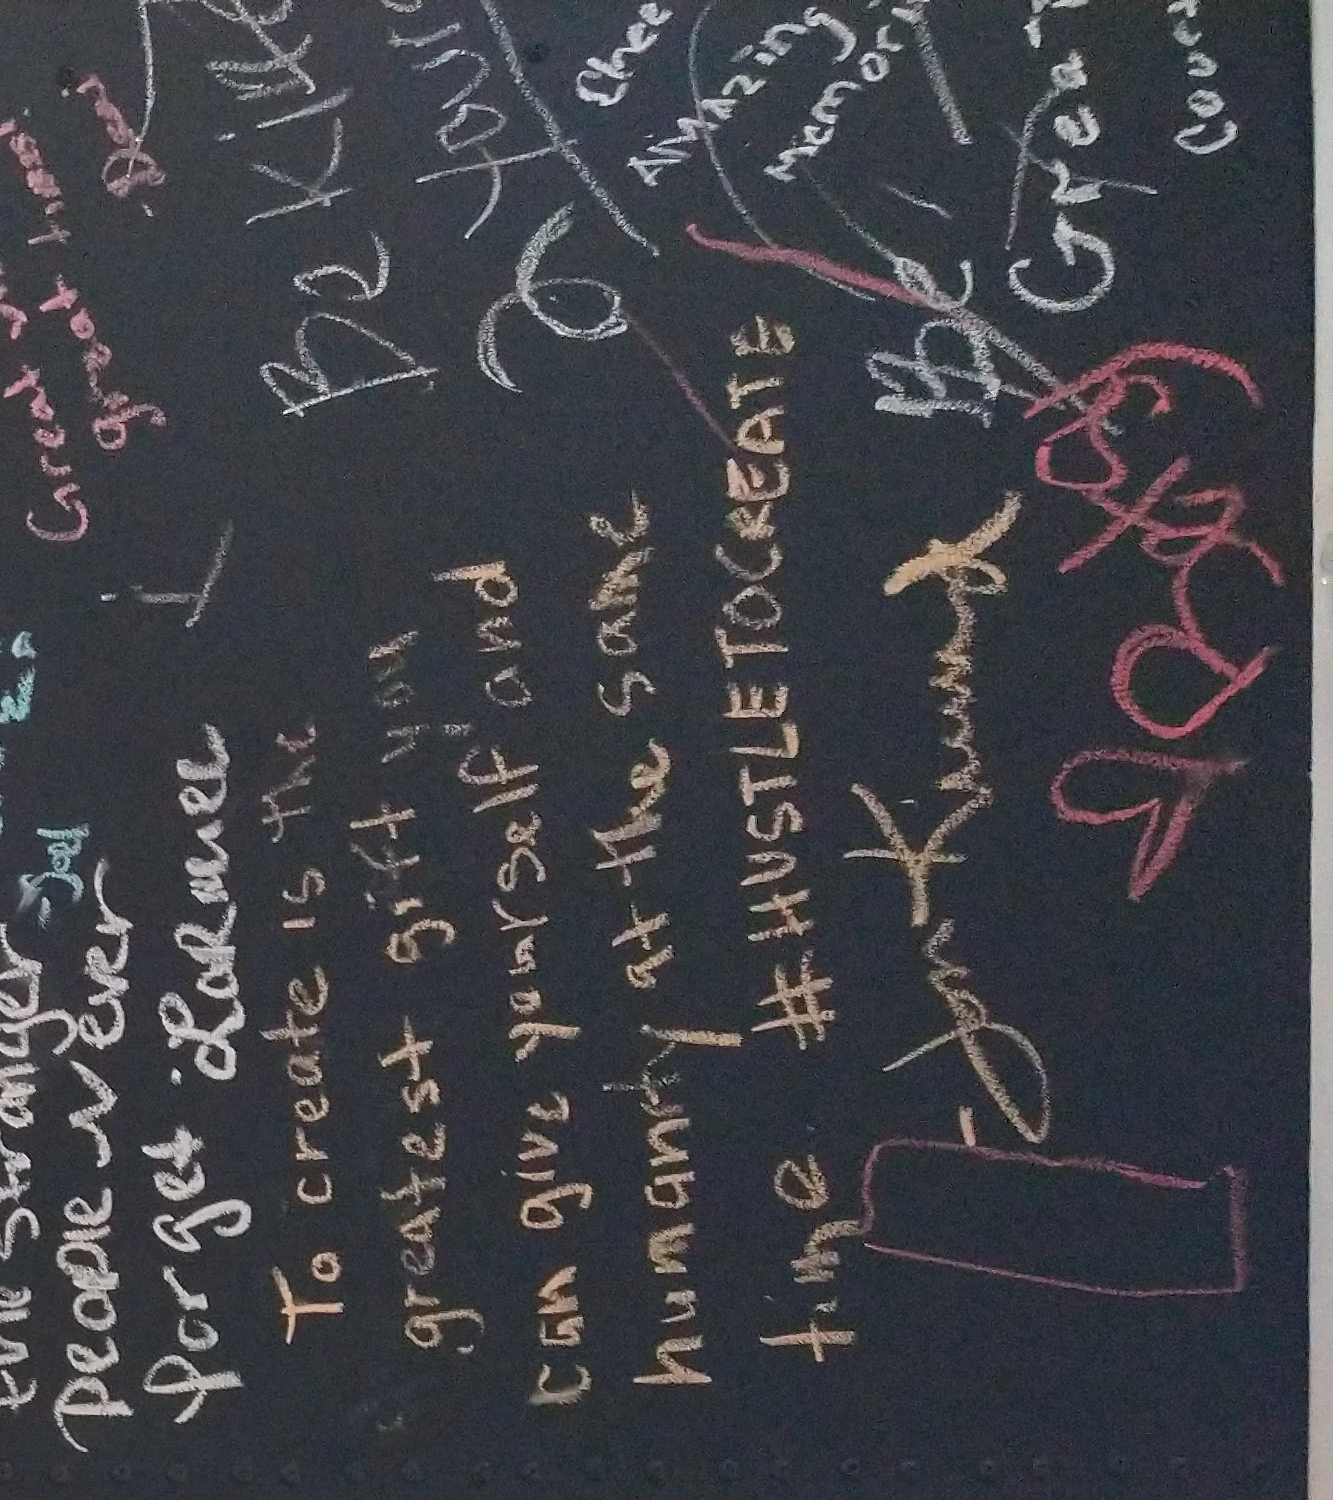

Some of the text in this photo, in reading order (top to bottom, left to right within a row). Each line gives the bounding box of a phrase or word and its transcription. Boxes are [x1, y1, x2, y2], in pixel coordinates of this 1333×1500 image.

[588, 492, 657, 717] same
[349, 801, 455, 963] gift
[591, 740, 673, 886] the
[431, 560, 591, 1403] can give yourself and
[612, 905, 676, 989] at
[261, 966, 331, 1204] create
[379, 1016, 486, 1353] greatest
[272, 1251, 344, 1343] To
